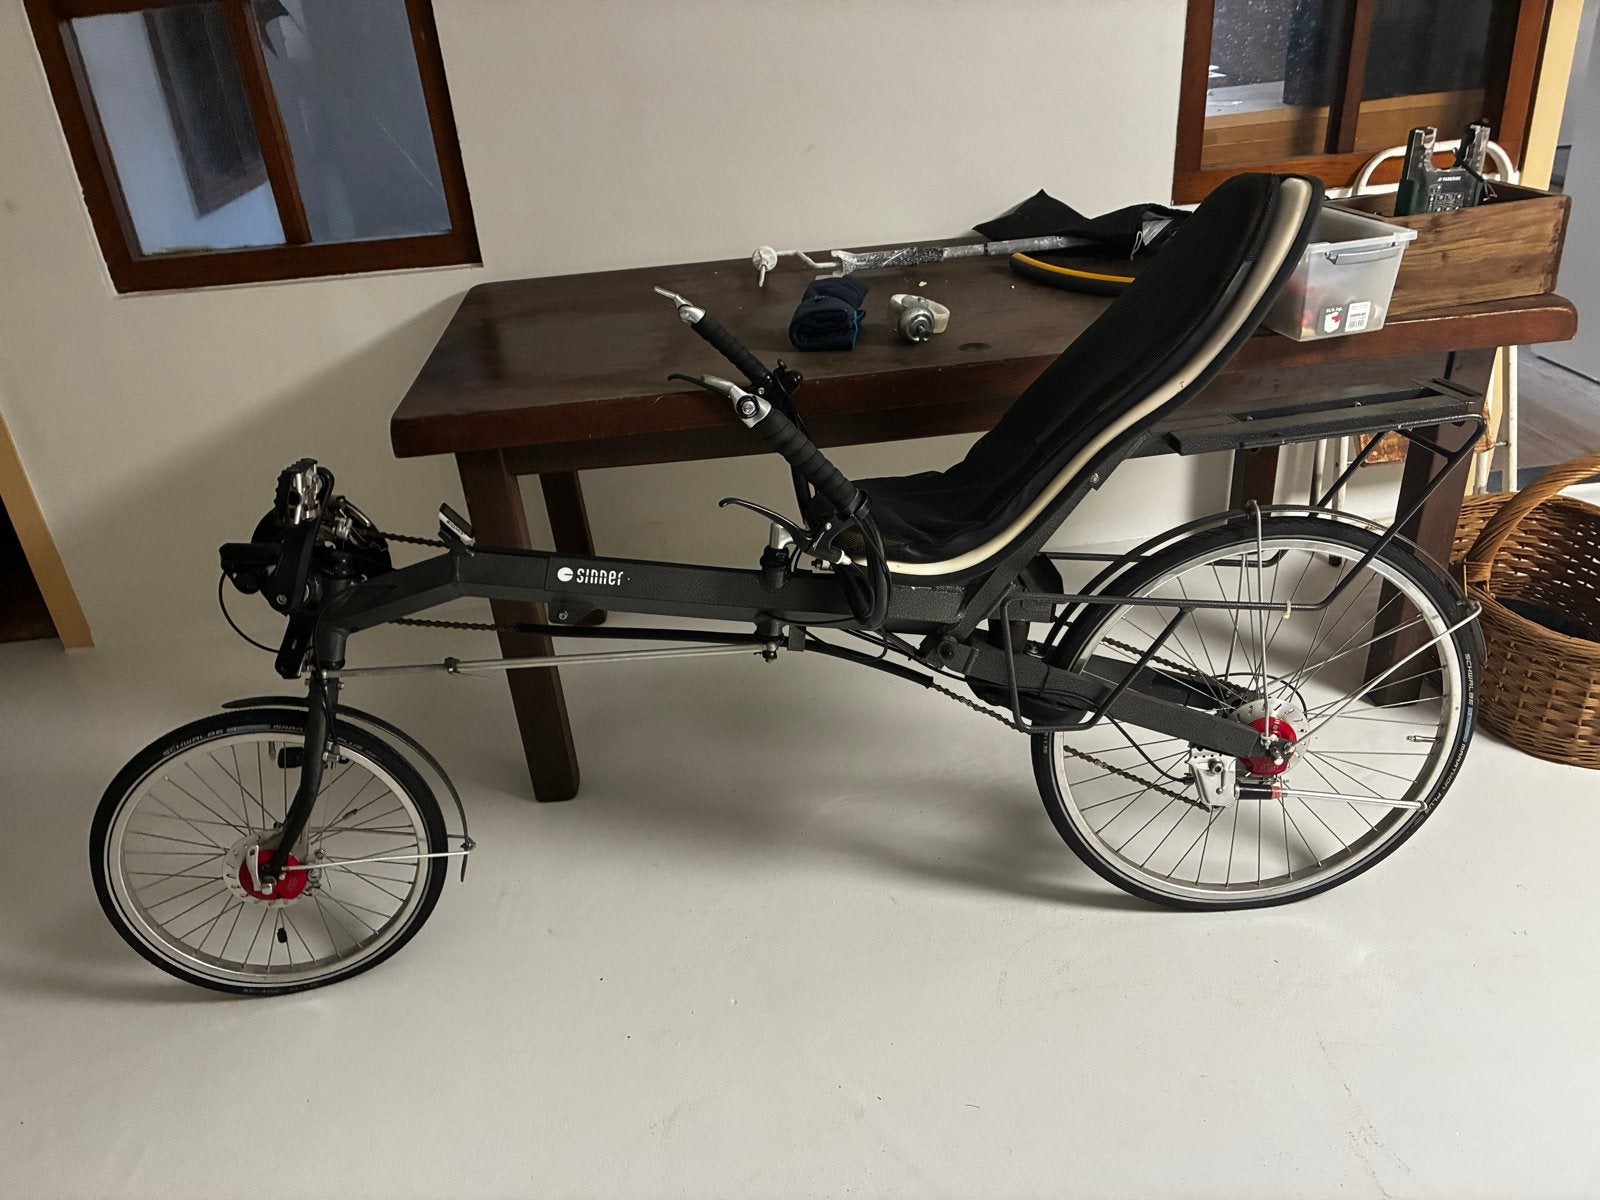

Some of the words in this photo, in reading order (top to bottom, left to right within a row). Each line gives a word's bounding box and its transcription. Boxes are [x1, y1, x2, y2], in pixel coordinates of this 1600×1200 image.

[1464, 653, 1474, 706] SCHWALBE
[162, 727, 224, 757] SCHWALBE
[1442, 743, 1466, 790] MARATHON
